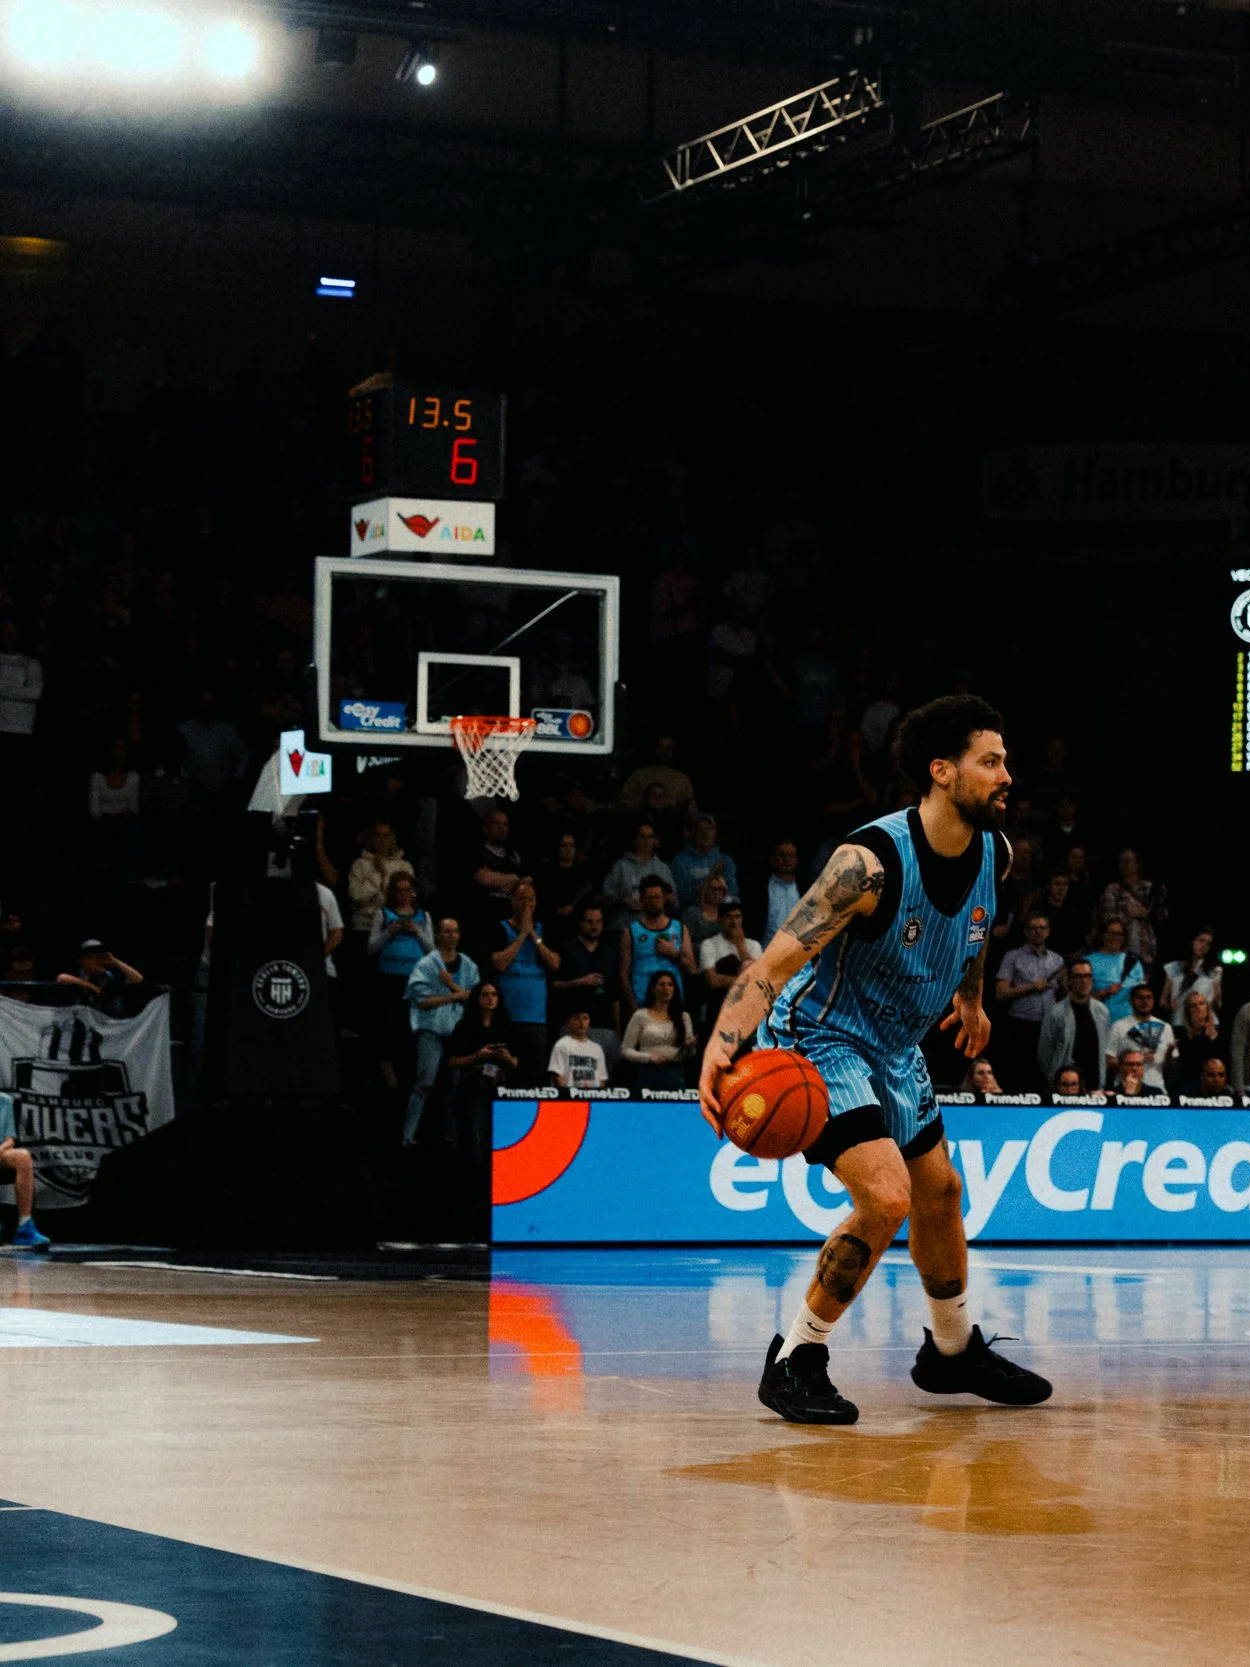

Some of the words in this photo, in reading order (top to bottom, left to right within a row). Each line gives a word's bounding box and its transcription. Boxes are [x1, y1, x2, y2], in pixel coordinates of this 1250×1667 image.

[408, 396, 473, 432] 13.5
[449, 436, 479, 486] 6
[440, 526, 486, 542] AIDA
[497, 1087, 559, 1099] PrimeLED
[569, 1087, 630, 1099] PrimeLED
[935, 1092, 975, 1104] meLED
[25, 1095, 109, 1107] HAMBURG
[18, 1094, 149, 1147] OWERS
